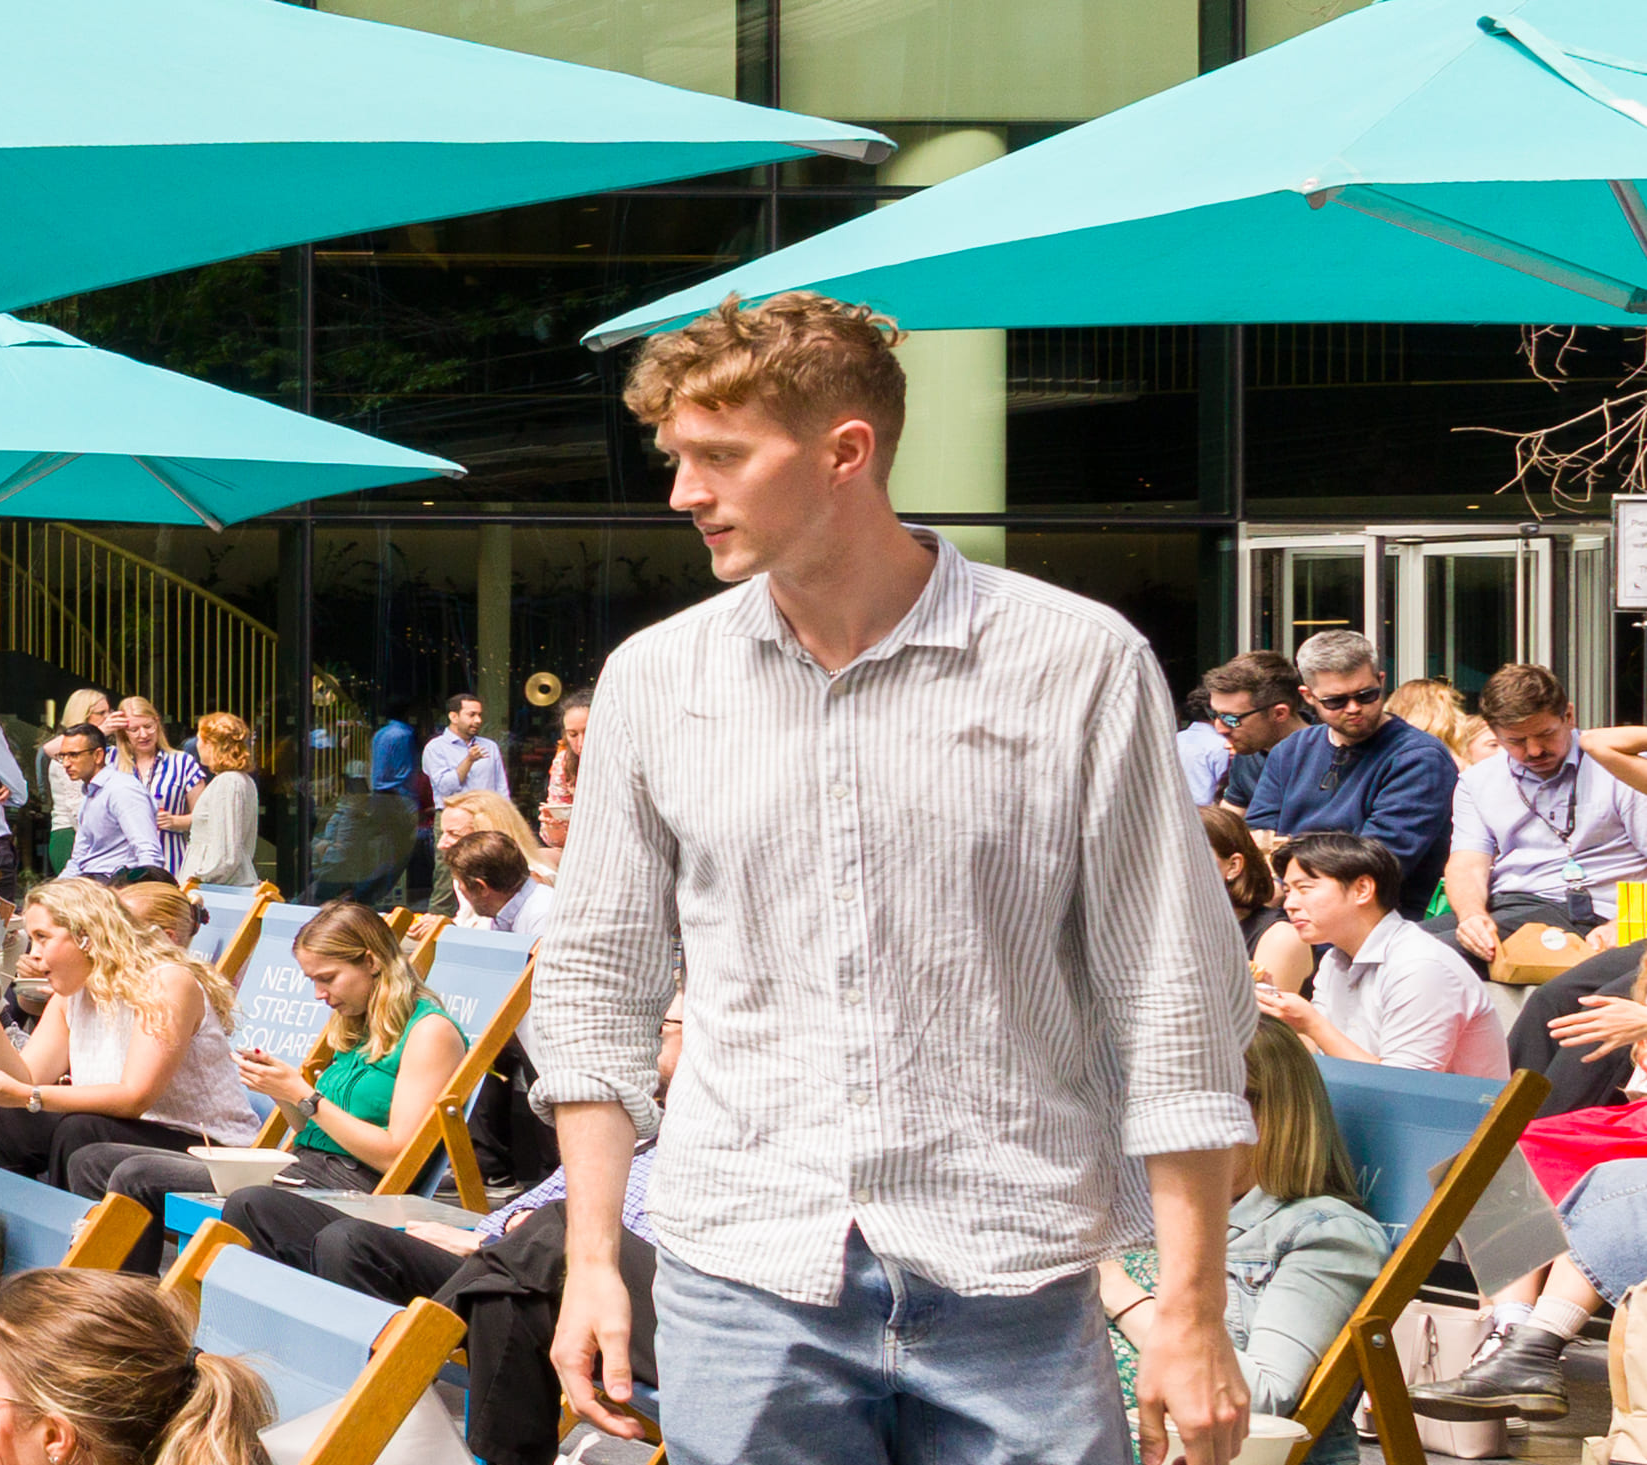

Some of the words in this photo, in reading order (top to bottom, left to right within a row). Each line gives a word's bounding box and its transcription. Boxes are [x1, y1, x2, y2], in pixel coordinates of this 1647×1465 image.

[260, 965, 312, 994] NEW
[249, 995, 325, 1028] STREET
[236, 1024, 319, 1059] SQUARE
